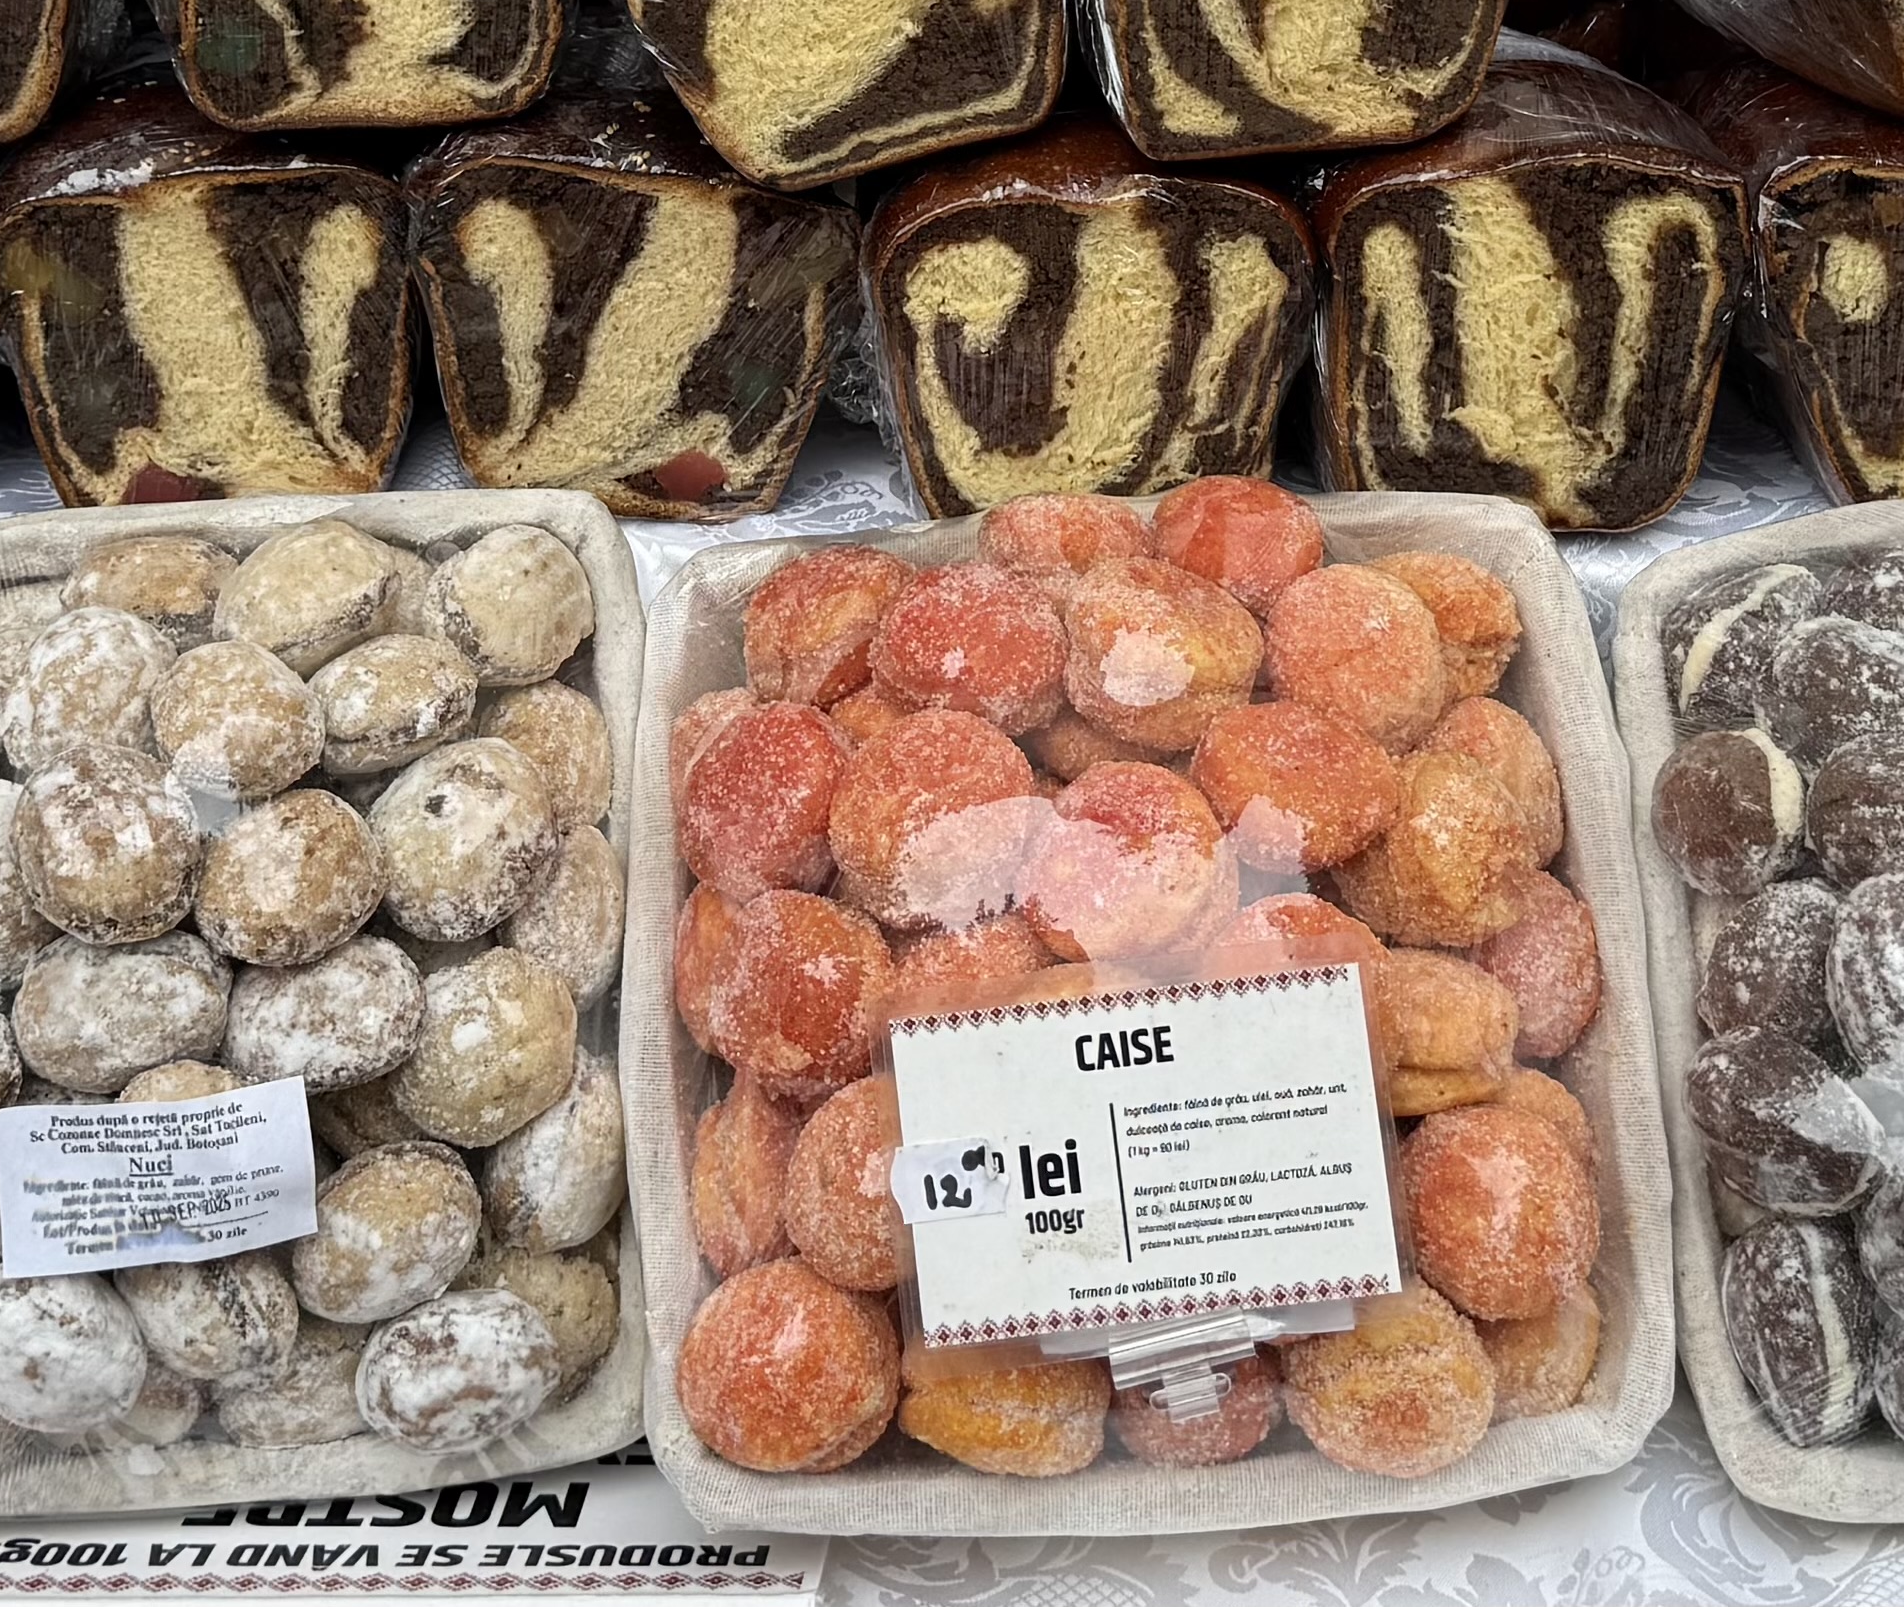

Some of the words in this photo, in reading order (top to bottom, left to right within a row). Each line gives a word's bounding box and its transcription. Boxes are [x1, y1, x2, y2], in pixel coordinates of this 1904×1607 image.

[1074, 1024, 1175, 1073] CAISE
[129, 1154, 173, 1175] Nuci
[1019, 1138, 1082, 1200] lei
[1025, 1208, 1086, 1236] 100gr
[1069, 1286, 1112, 1300] Termen
[1115, 1283, 1128, 1294] de
[1200, 1272, 1213, 1285] 30
[147, 1540, 213, 1567] LA
[400, 1542, 468, 1567] SE
[488, 1542, 770, 1567] PRODUSLE
